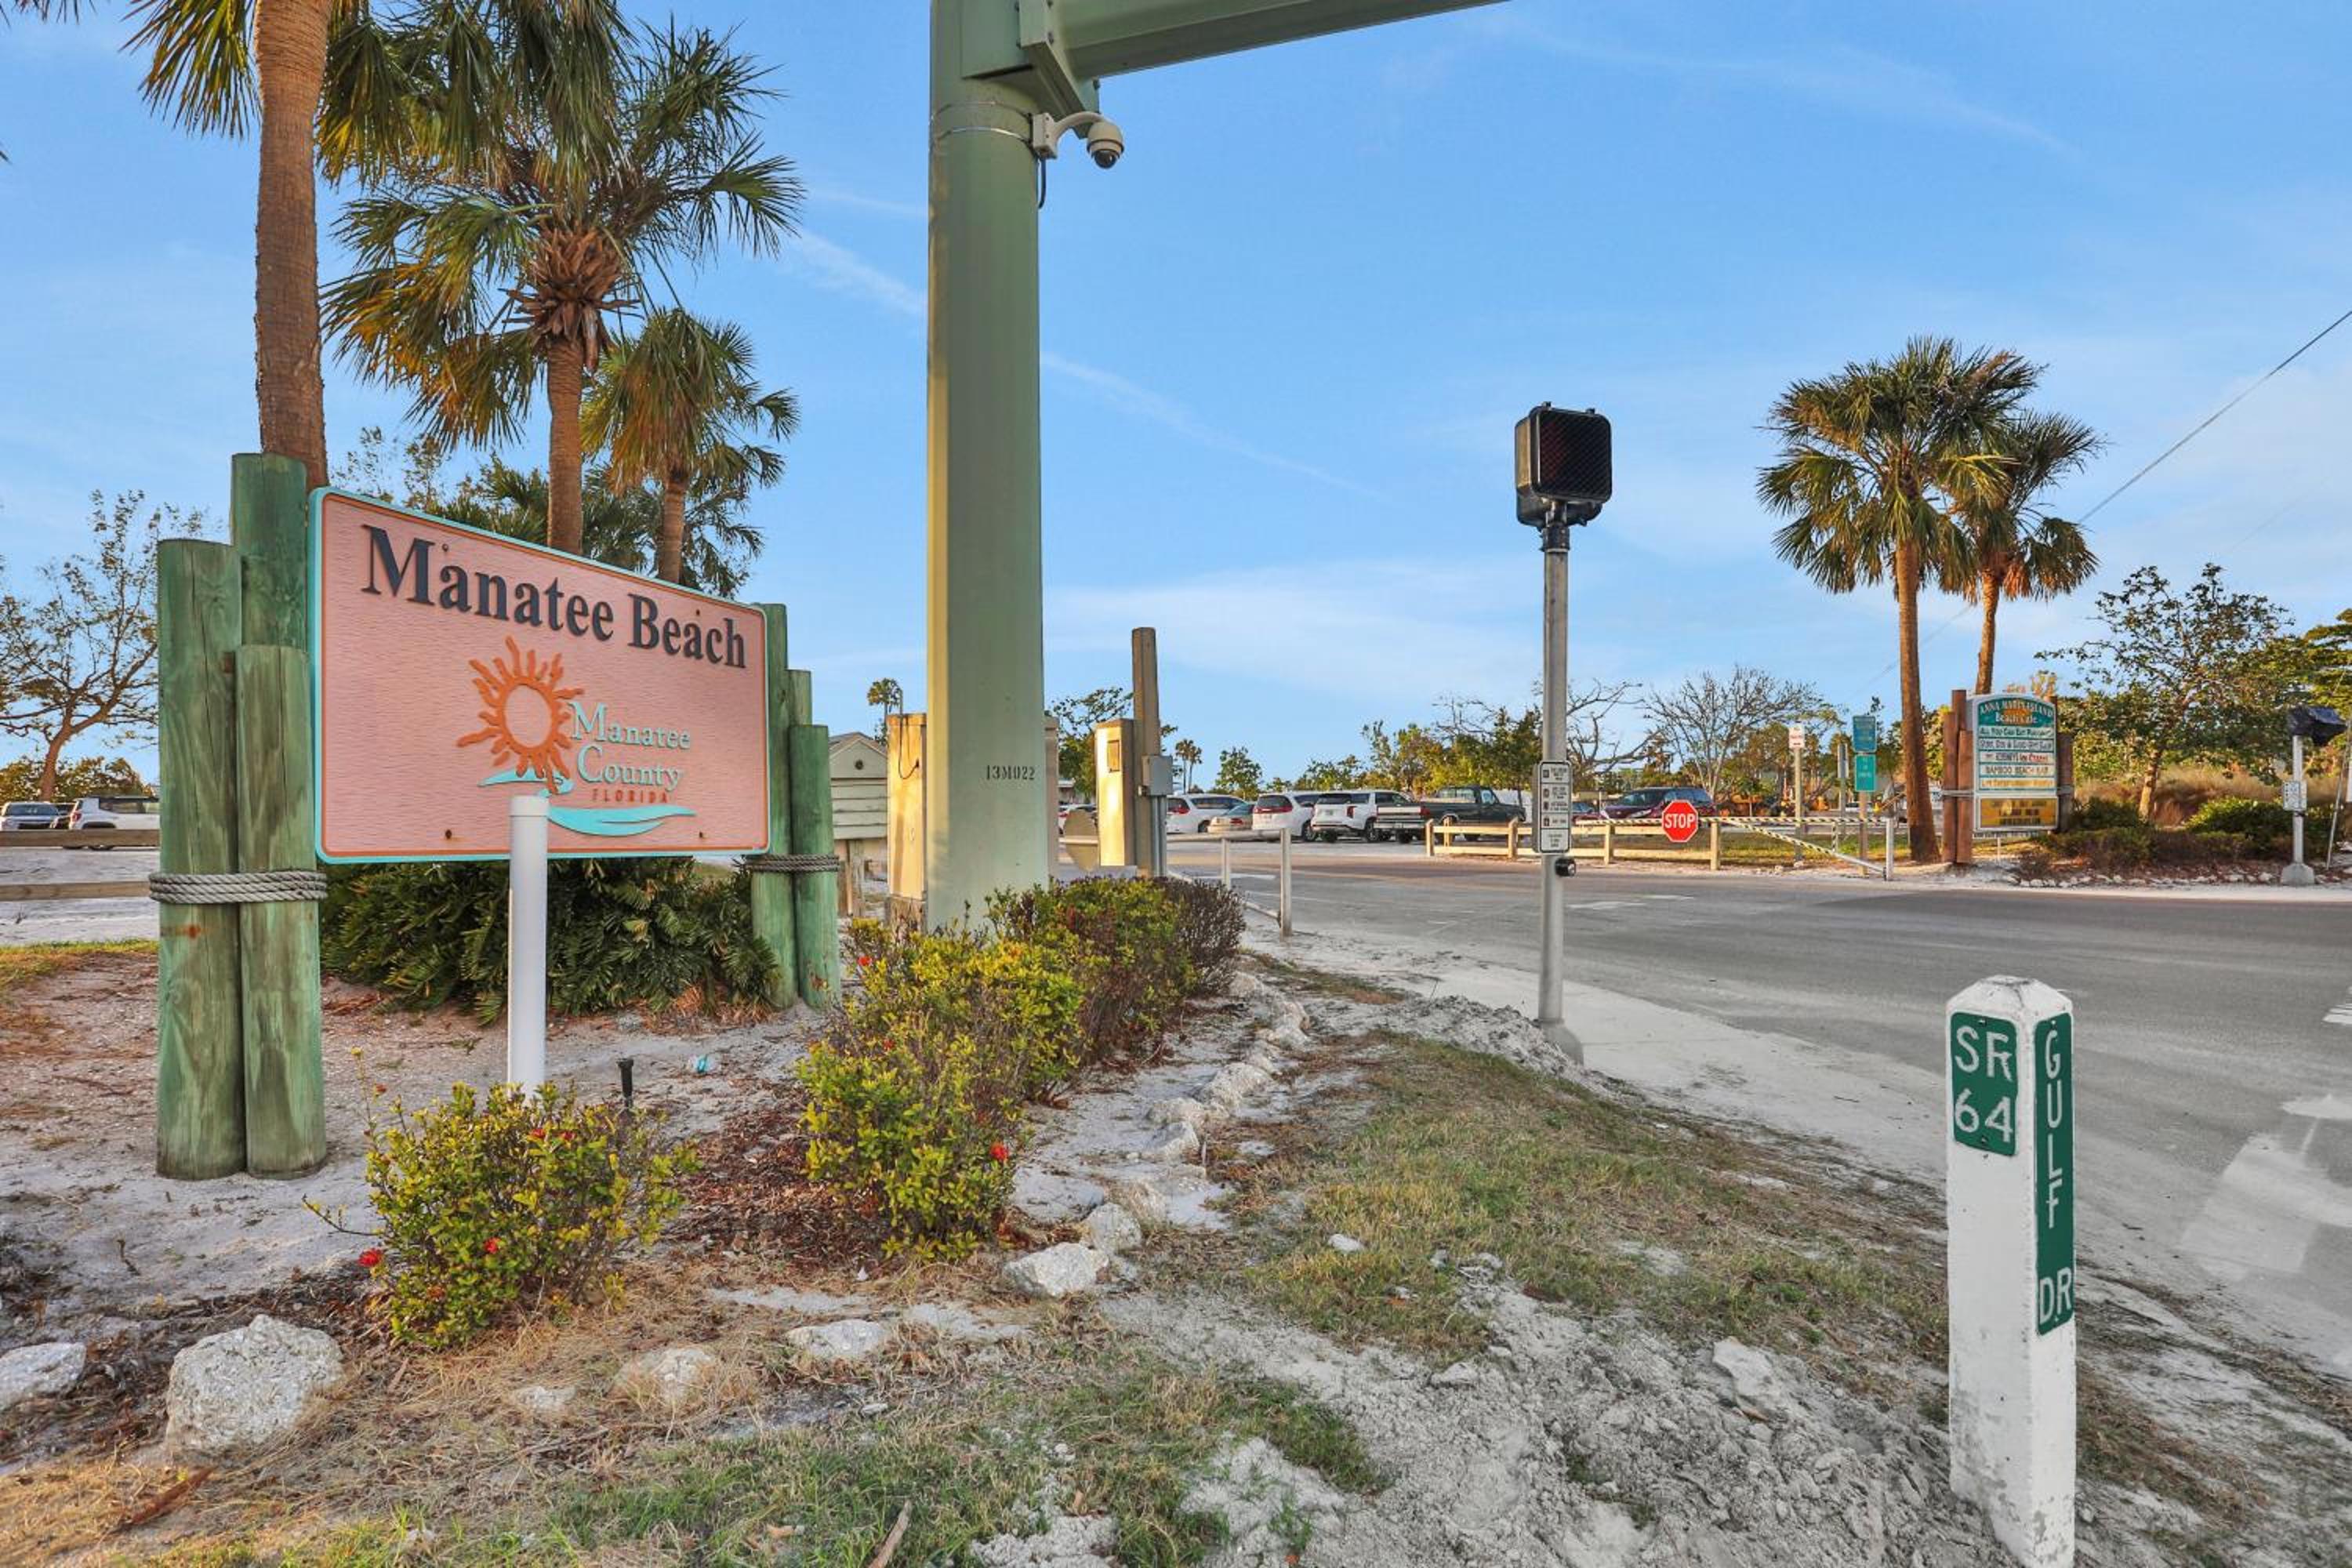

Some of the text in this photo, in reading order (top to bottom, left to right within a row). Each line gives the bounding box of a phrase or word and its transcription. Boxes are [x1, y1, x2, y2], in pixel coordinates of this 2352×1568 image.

[361, 524, 747, 669] Manatee Beach
[568, 701, 691, 750] Manatee
[577, 744, 685, 792] County
[592, 789, 669, 804] FLORIDA
[1664, 813, 1696, 829] STOP
[1955, 1025, 2013, 1082] SR
[1955, 1087, 2013, 1143] 64
[2045, 1029, 2063, 1229] GULF
[2039, 1267, 2072, 1325] DR
